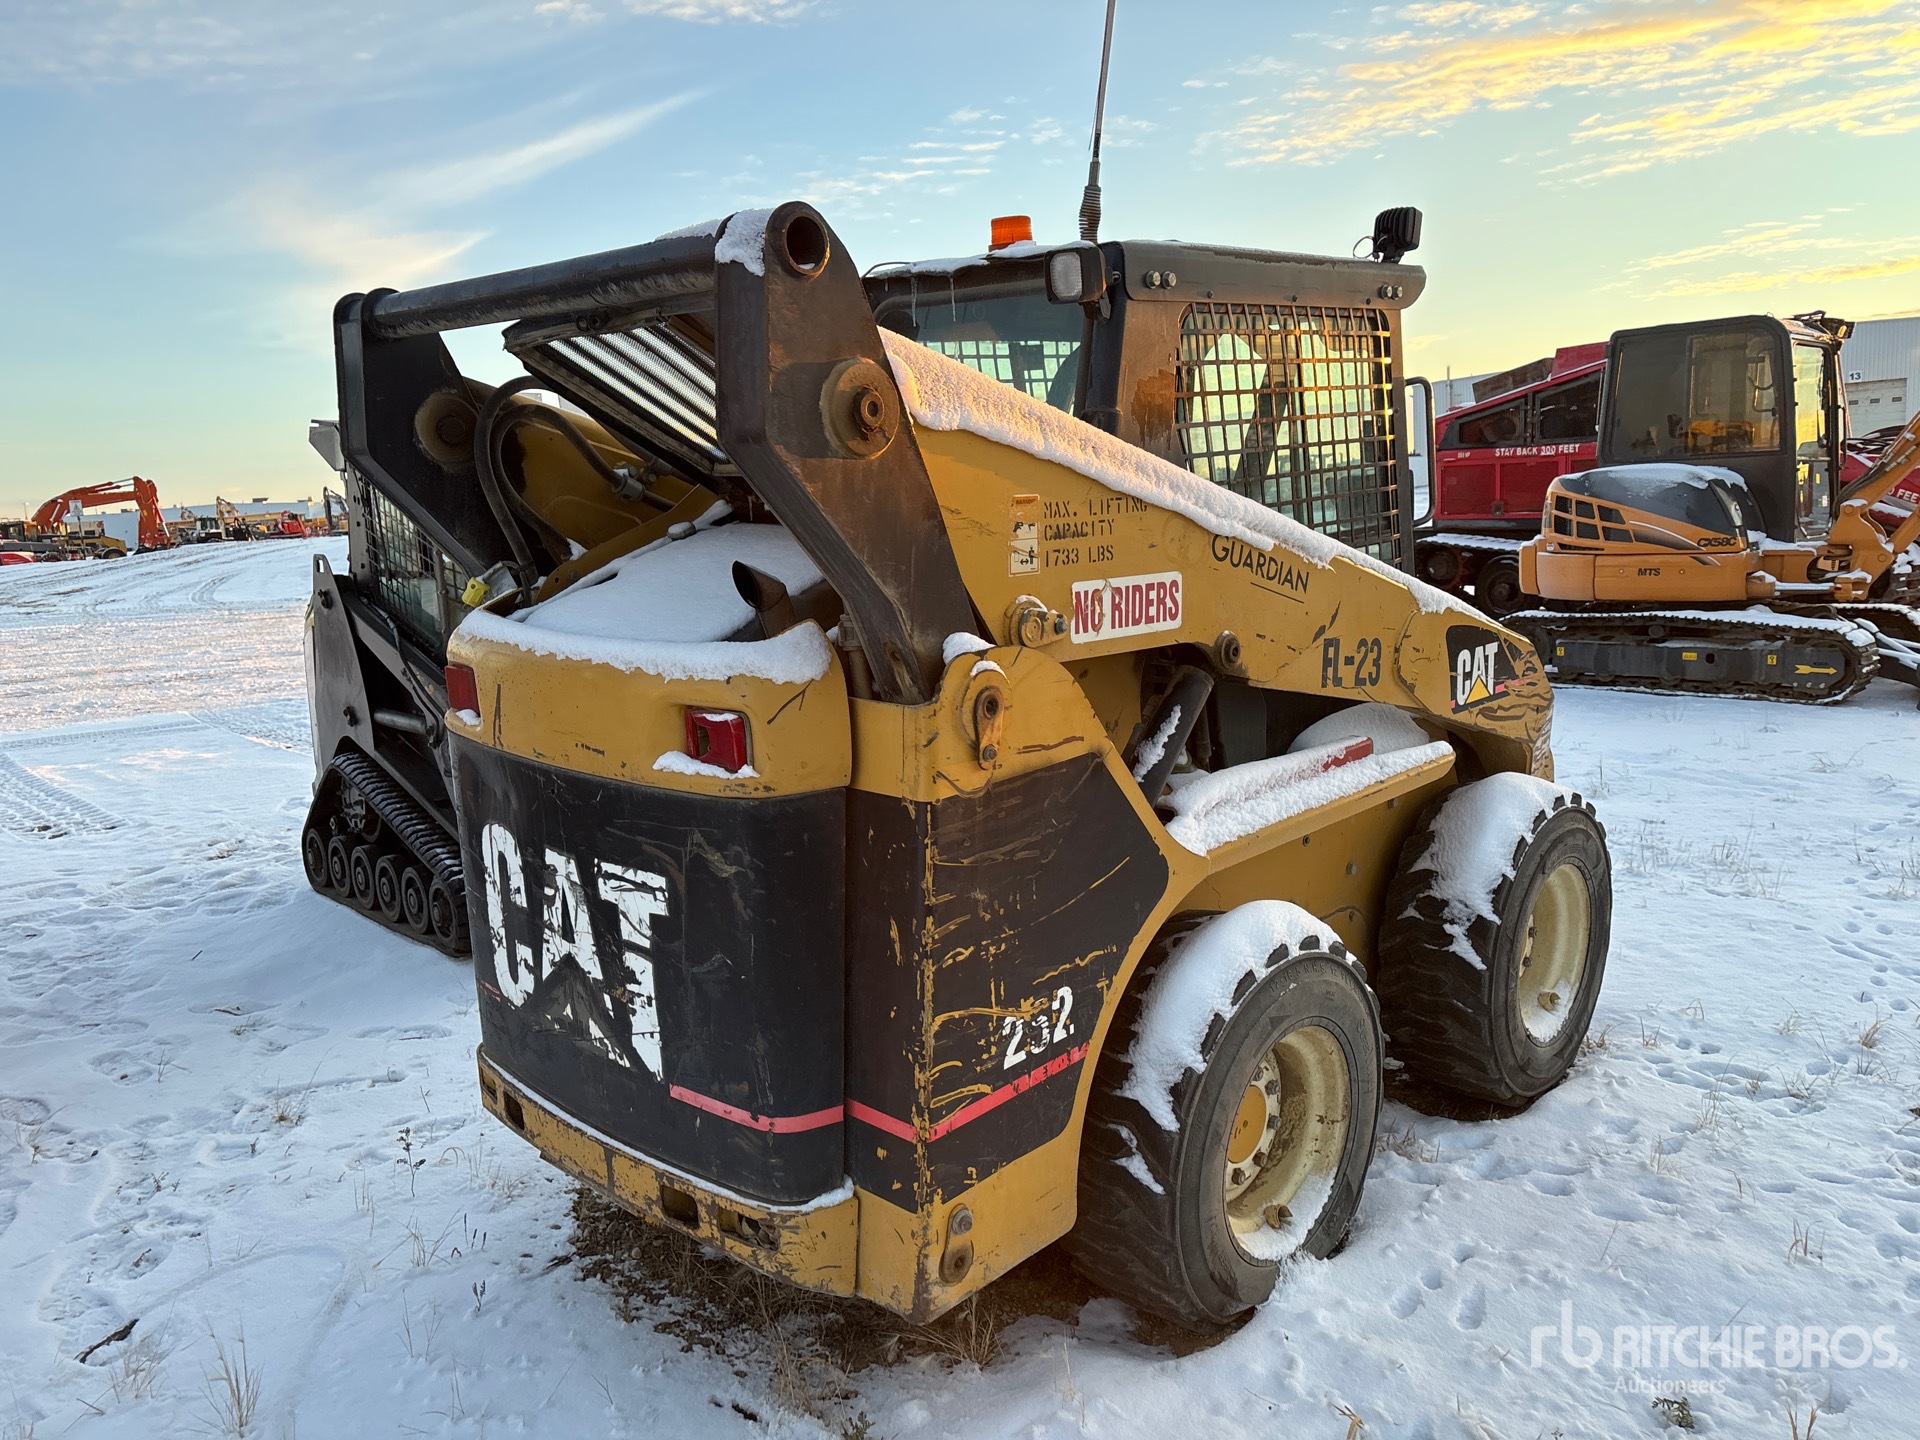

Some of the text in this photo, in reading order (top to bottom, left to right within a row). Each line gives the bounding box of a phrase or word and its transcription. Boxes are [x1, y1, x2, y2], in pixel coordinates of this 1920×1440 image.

[1849, 372, 1861, 380] 13
[1495, 444, 1580, 457] STAY BACK 300 FEET
[1896, 488, 1920, 506] FEE
[1044, 500, 1078, 519] MAX.
[1044, 519, 1115, 542] CAPACITY
[1045, 545, 1114, 568] 1733 LBS
[1211, 534, 1309, 594] GUARDIAN
[1637, 567, 1661, 577] MTS
[1074, 579, 1180, 635] NO RIDERS
[1321, 637, 1382, 689] FL-23
[1456, 641, 1500, 706] CAT
[482, 823, 669, 1081] CAT
